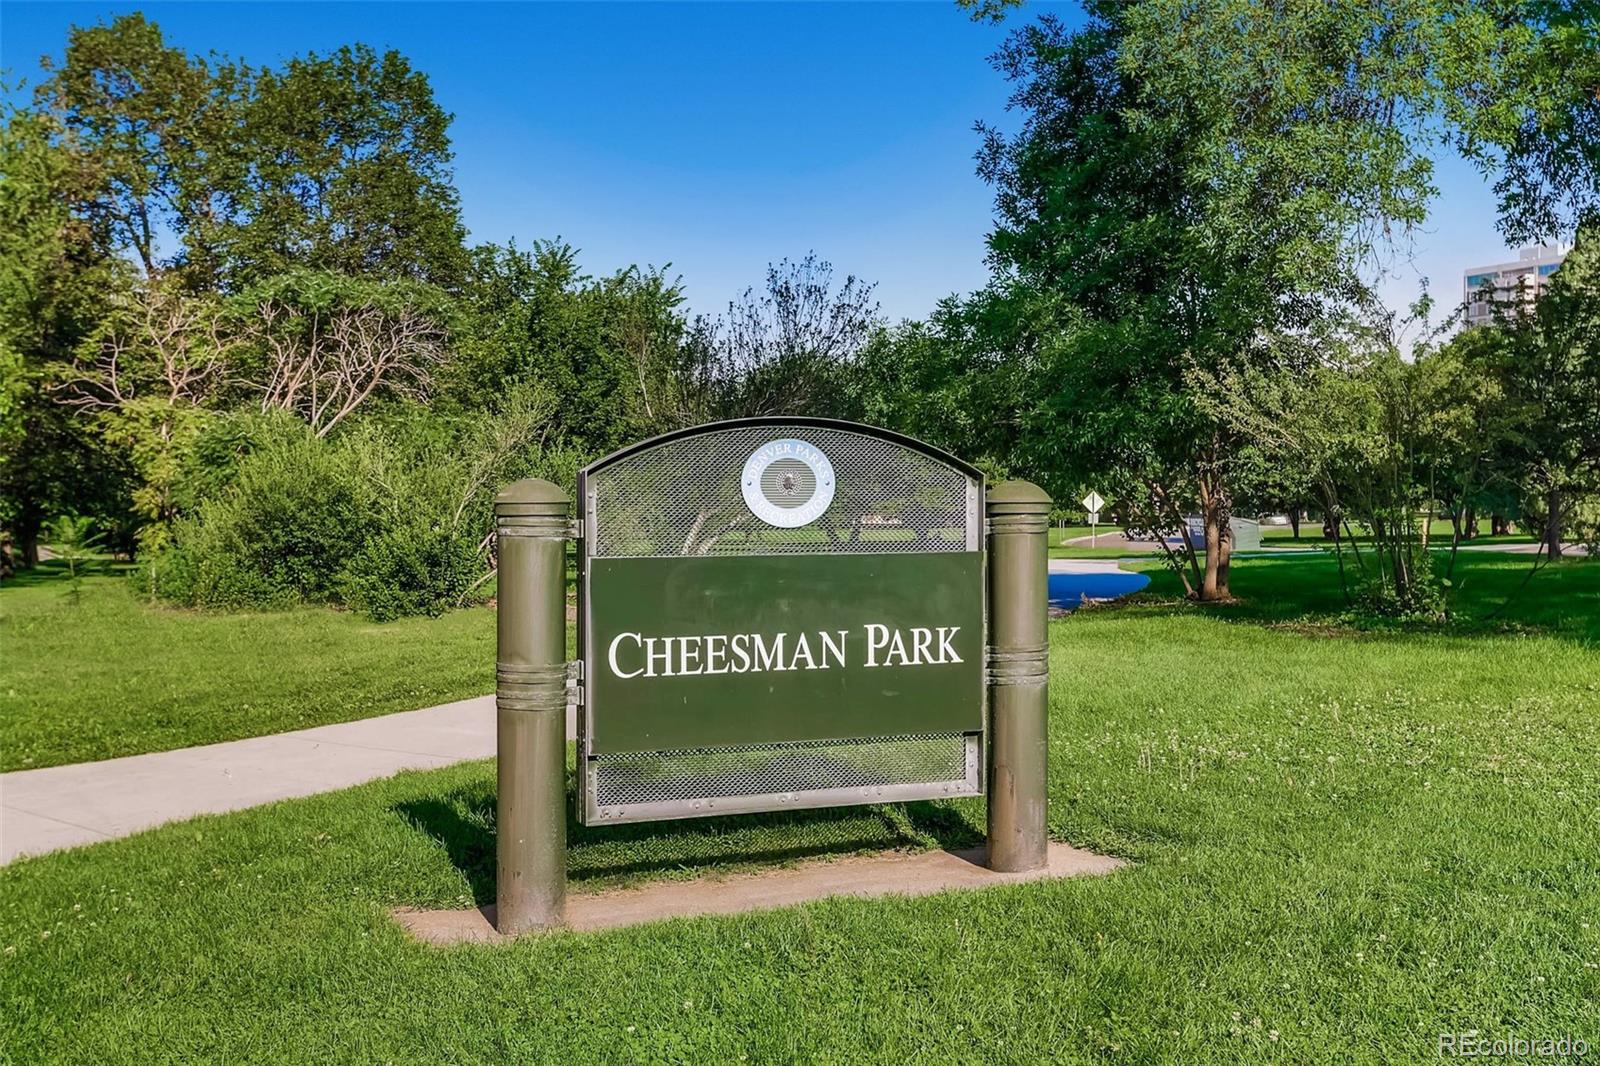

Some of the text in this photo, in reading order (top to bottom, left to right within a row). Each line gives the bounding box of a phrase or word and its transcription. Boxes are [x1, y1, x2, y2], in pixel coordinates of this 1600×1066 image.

[748, 443, 830, 479] DENVER PARKS
[863, 623, 964, 668] PARK
